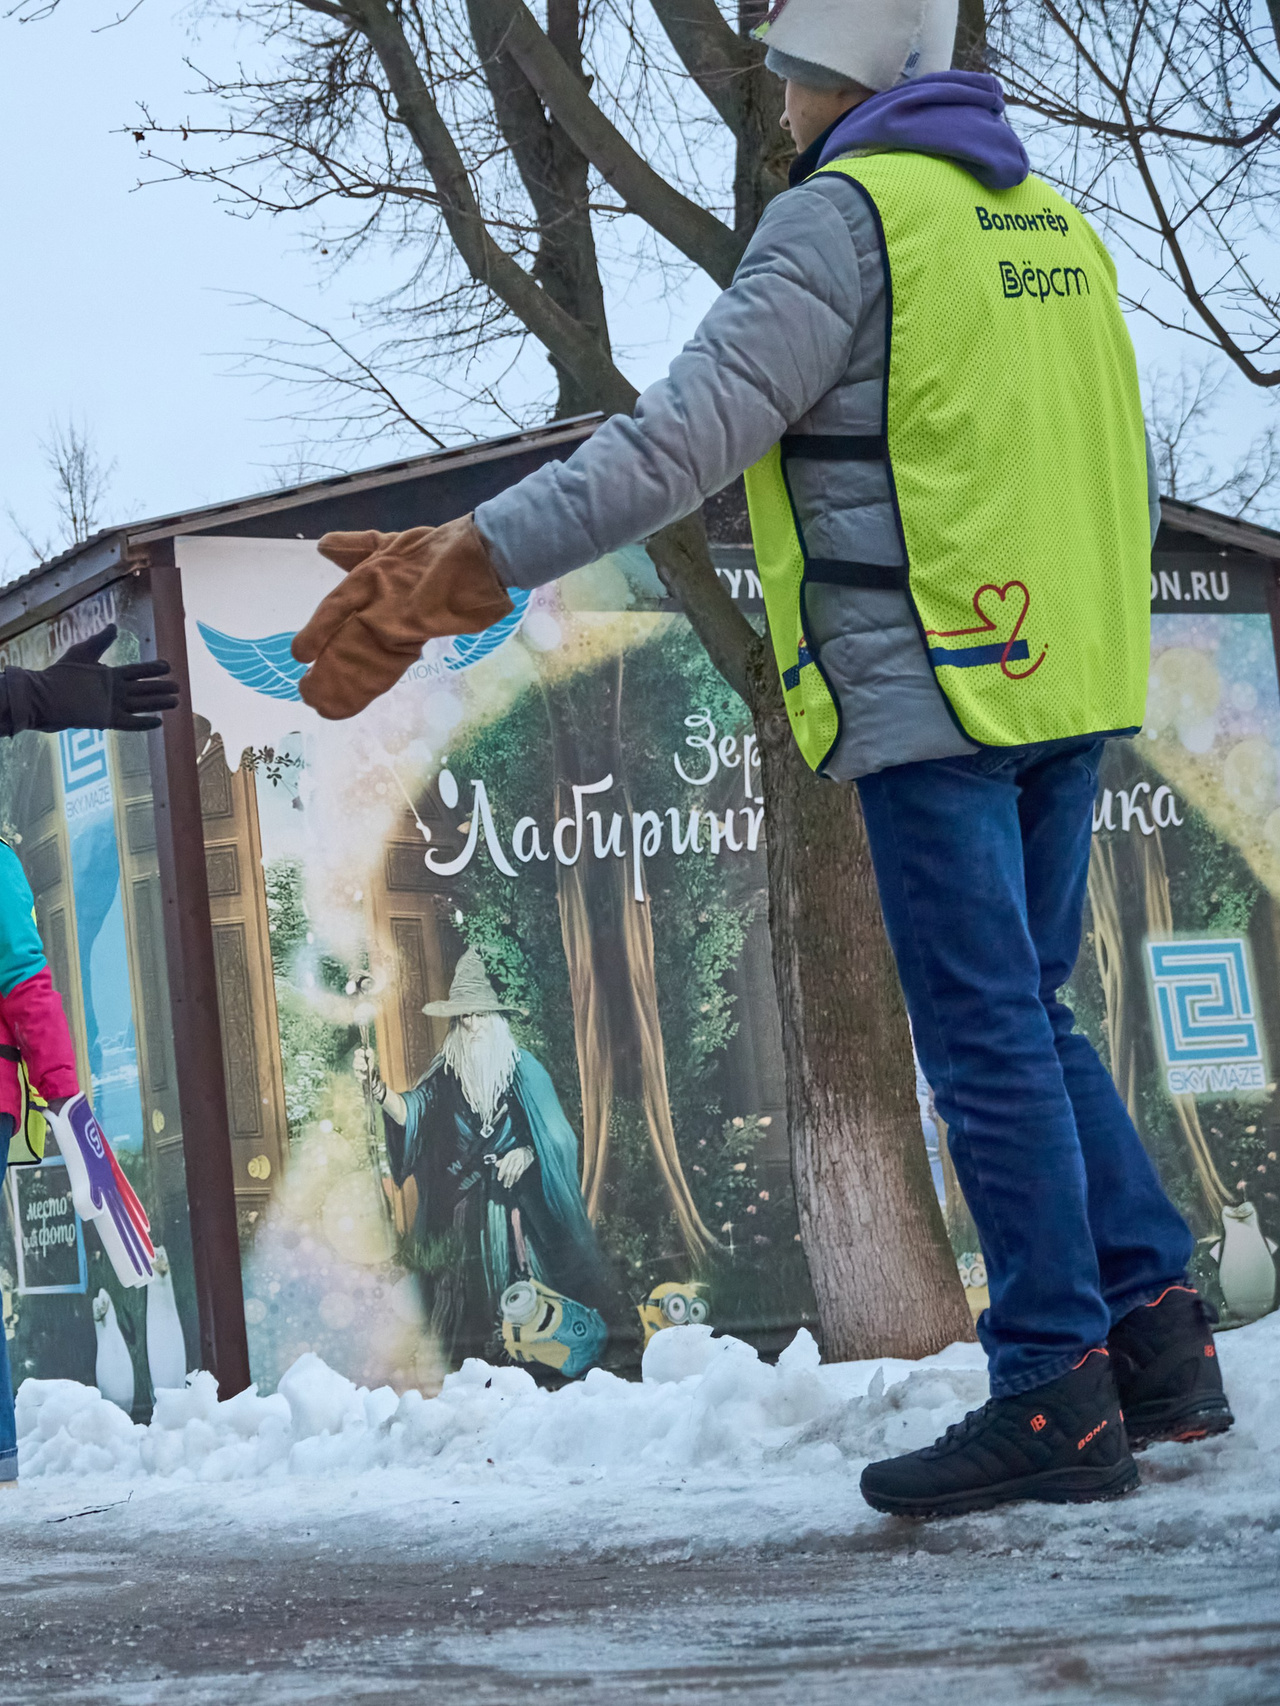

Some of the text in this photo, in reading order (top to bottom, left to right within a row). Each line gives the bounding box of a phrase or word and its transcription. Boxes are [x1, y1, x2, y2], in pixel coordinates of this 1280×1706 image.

[975, 206, 1069, 237] Волонтёр
[26, 1196, 68, 1221] место
[38, 1220, 76, 1258] фото
[1077, 1420, 1108, 1450] BONA
